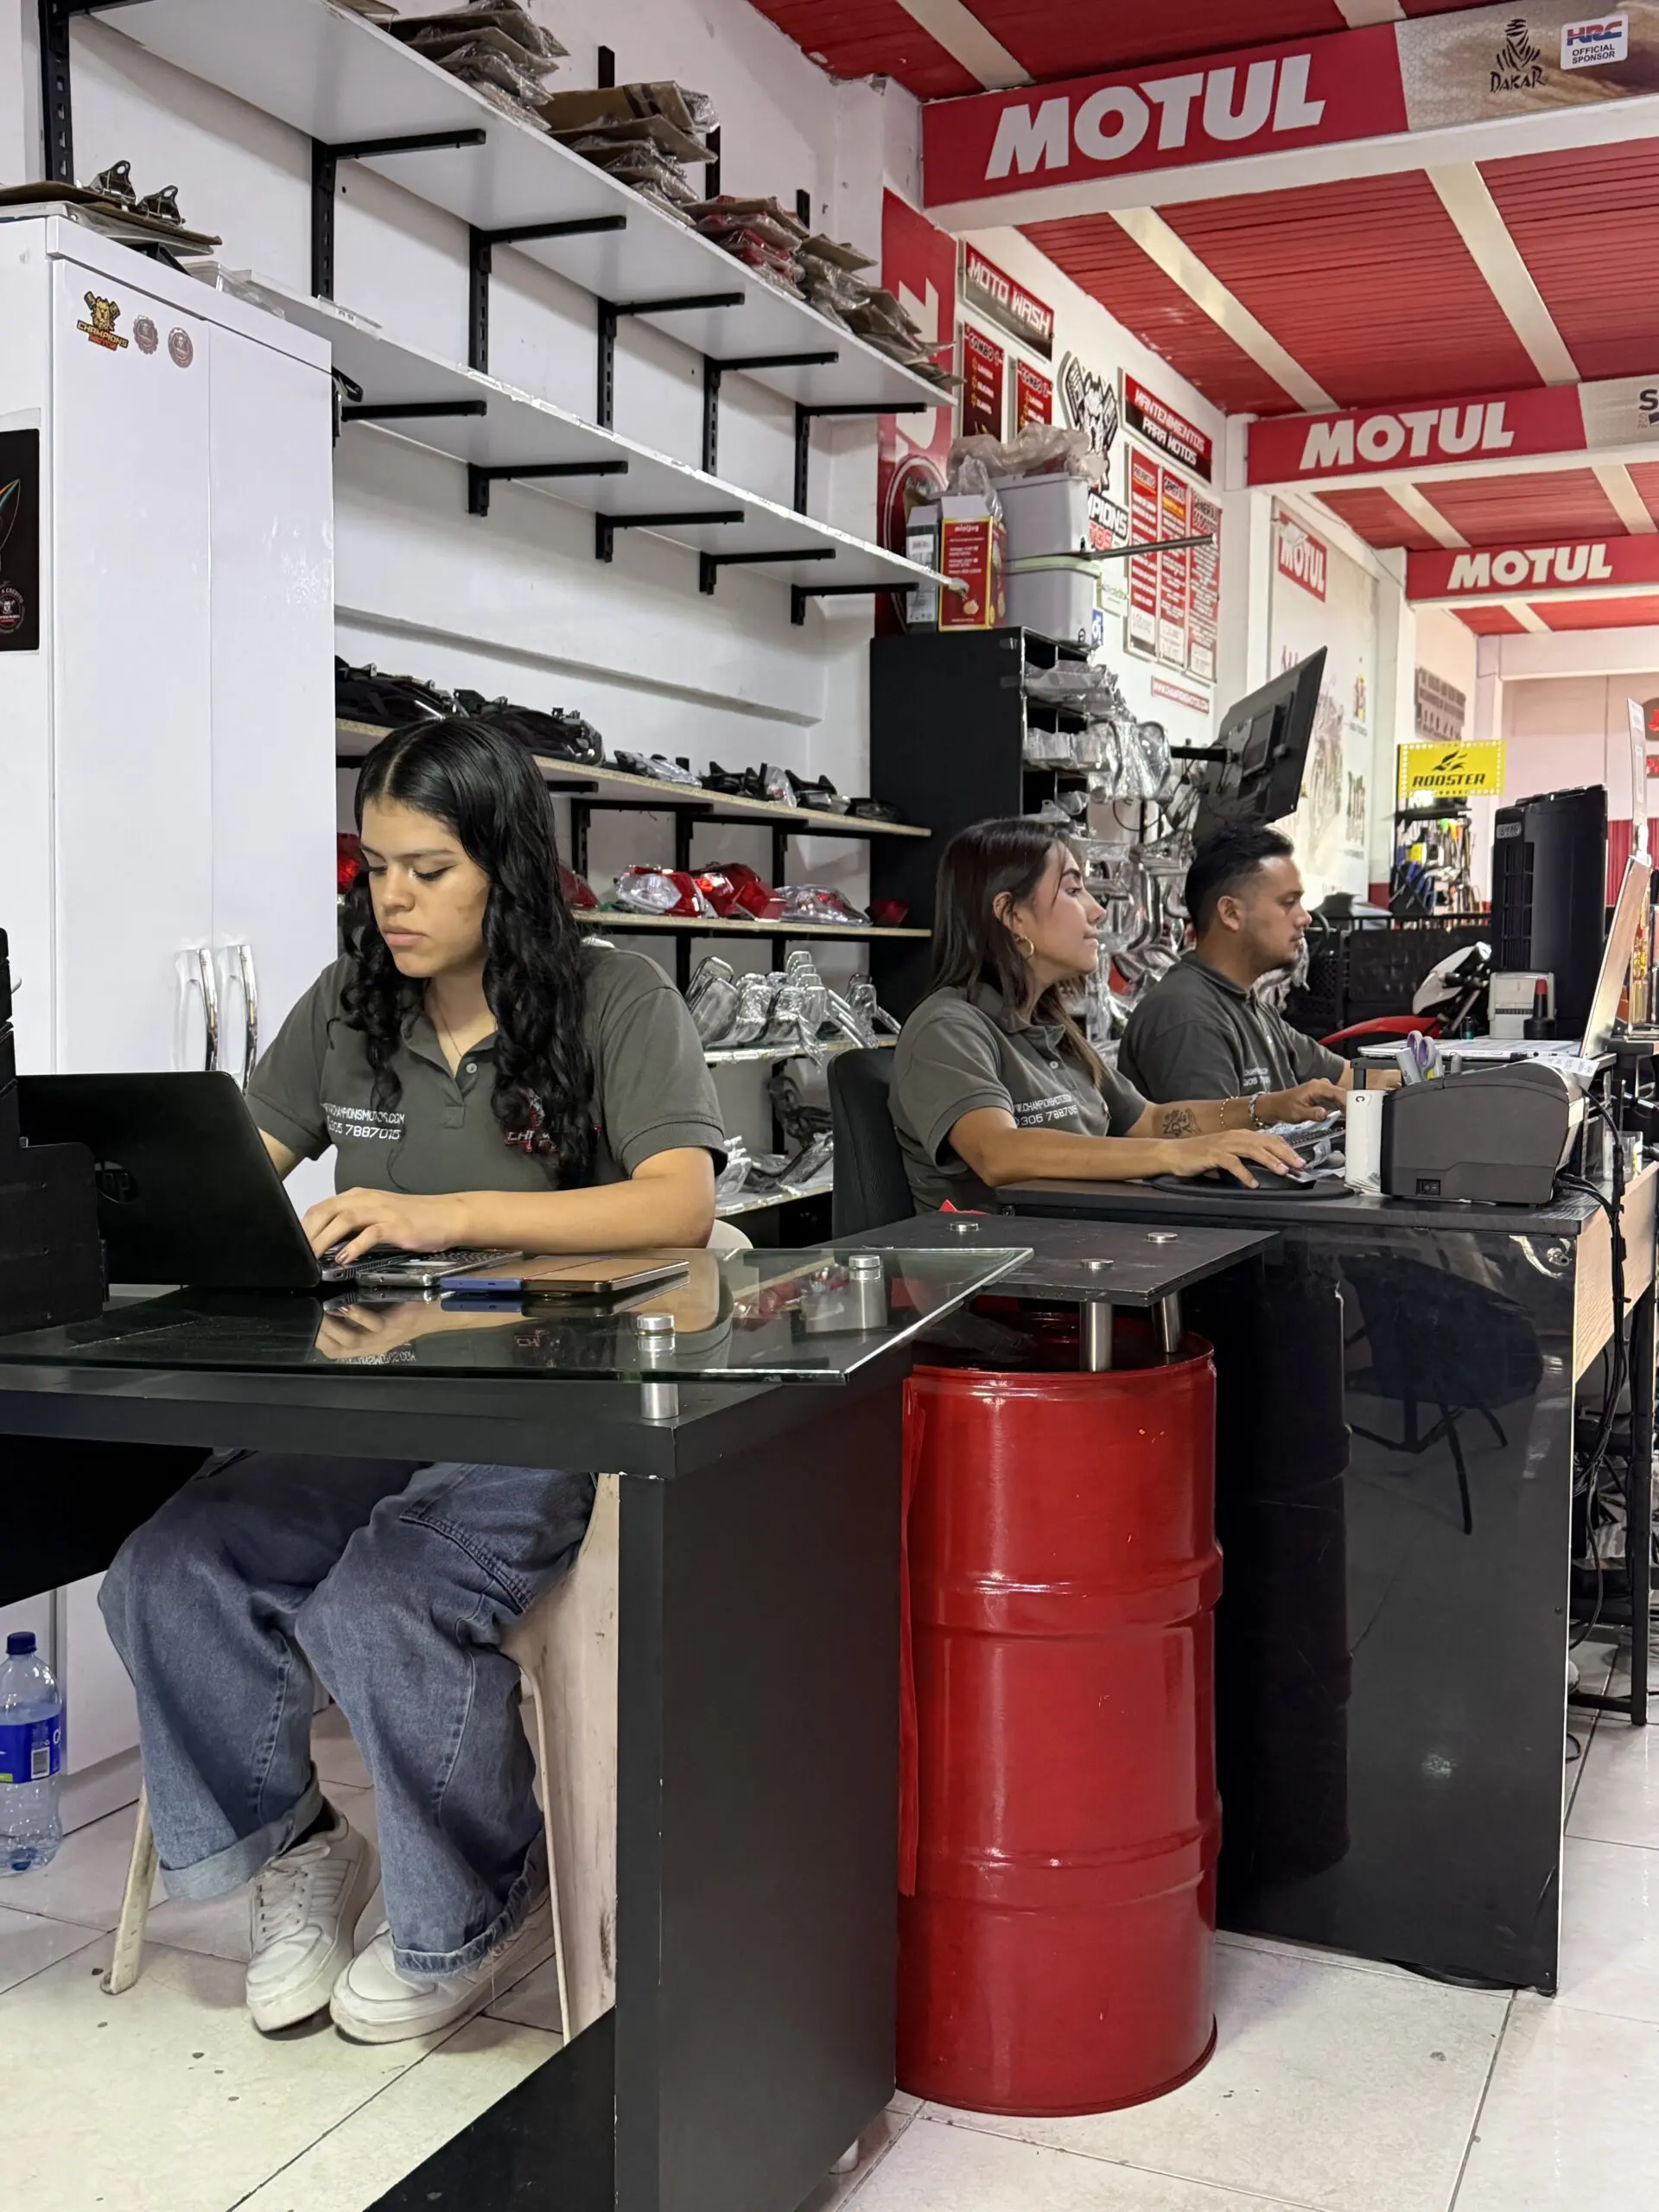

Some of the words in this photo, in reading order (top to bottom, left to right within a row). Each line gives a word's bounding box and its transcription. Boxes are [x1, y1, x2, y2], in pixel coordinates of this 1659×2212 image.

[1567, 21, 1623, 46] HRC
[1572, 44, 1615, 57] OFFICIAL
[1572, 50, 1616, 65] SPONSOR
[1489, 66, 1548, 93] DAKAR
[985, 54, 1325, 180] MOTUL
[967, 252, 1010, 305] MOTO
[1011, 286, 1052, 339] WASH
[78, 321, 128, 347] CHAMPIONS
[969, 331, 995, 362] COMBO
[1020, 367, 1042, 394] COMBO
[1135, 388, 1205, 455] MANTENIMIENTOS
[1142, 416, 1167, 447] PARA
[1167, 435, 1198, 466] MOTOS
[1299, 401, 1515, 470] MOTUL
[1281, 537, 1325, 594] MOTUL
[1446, 543, 1613, 590] MOTUL
[1412, 773, 1486, 787] ROOSTER
[346, 1123, 402, 1141] 7887015
[1021, 1114, 1044, 1126] 305
